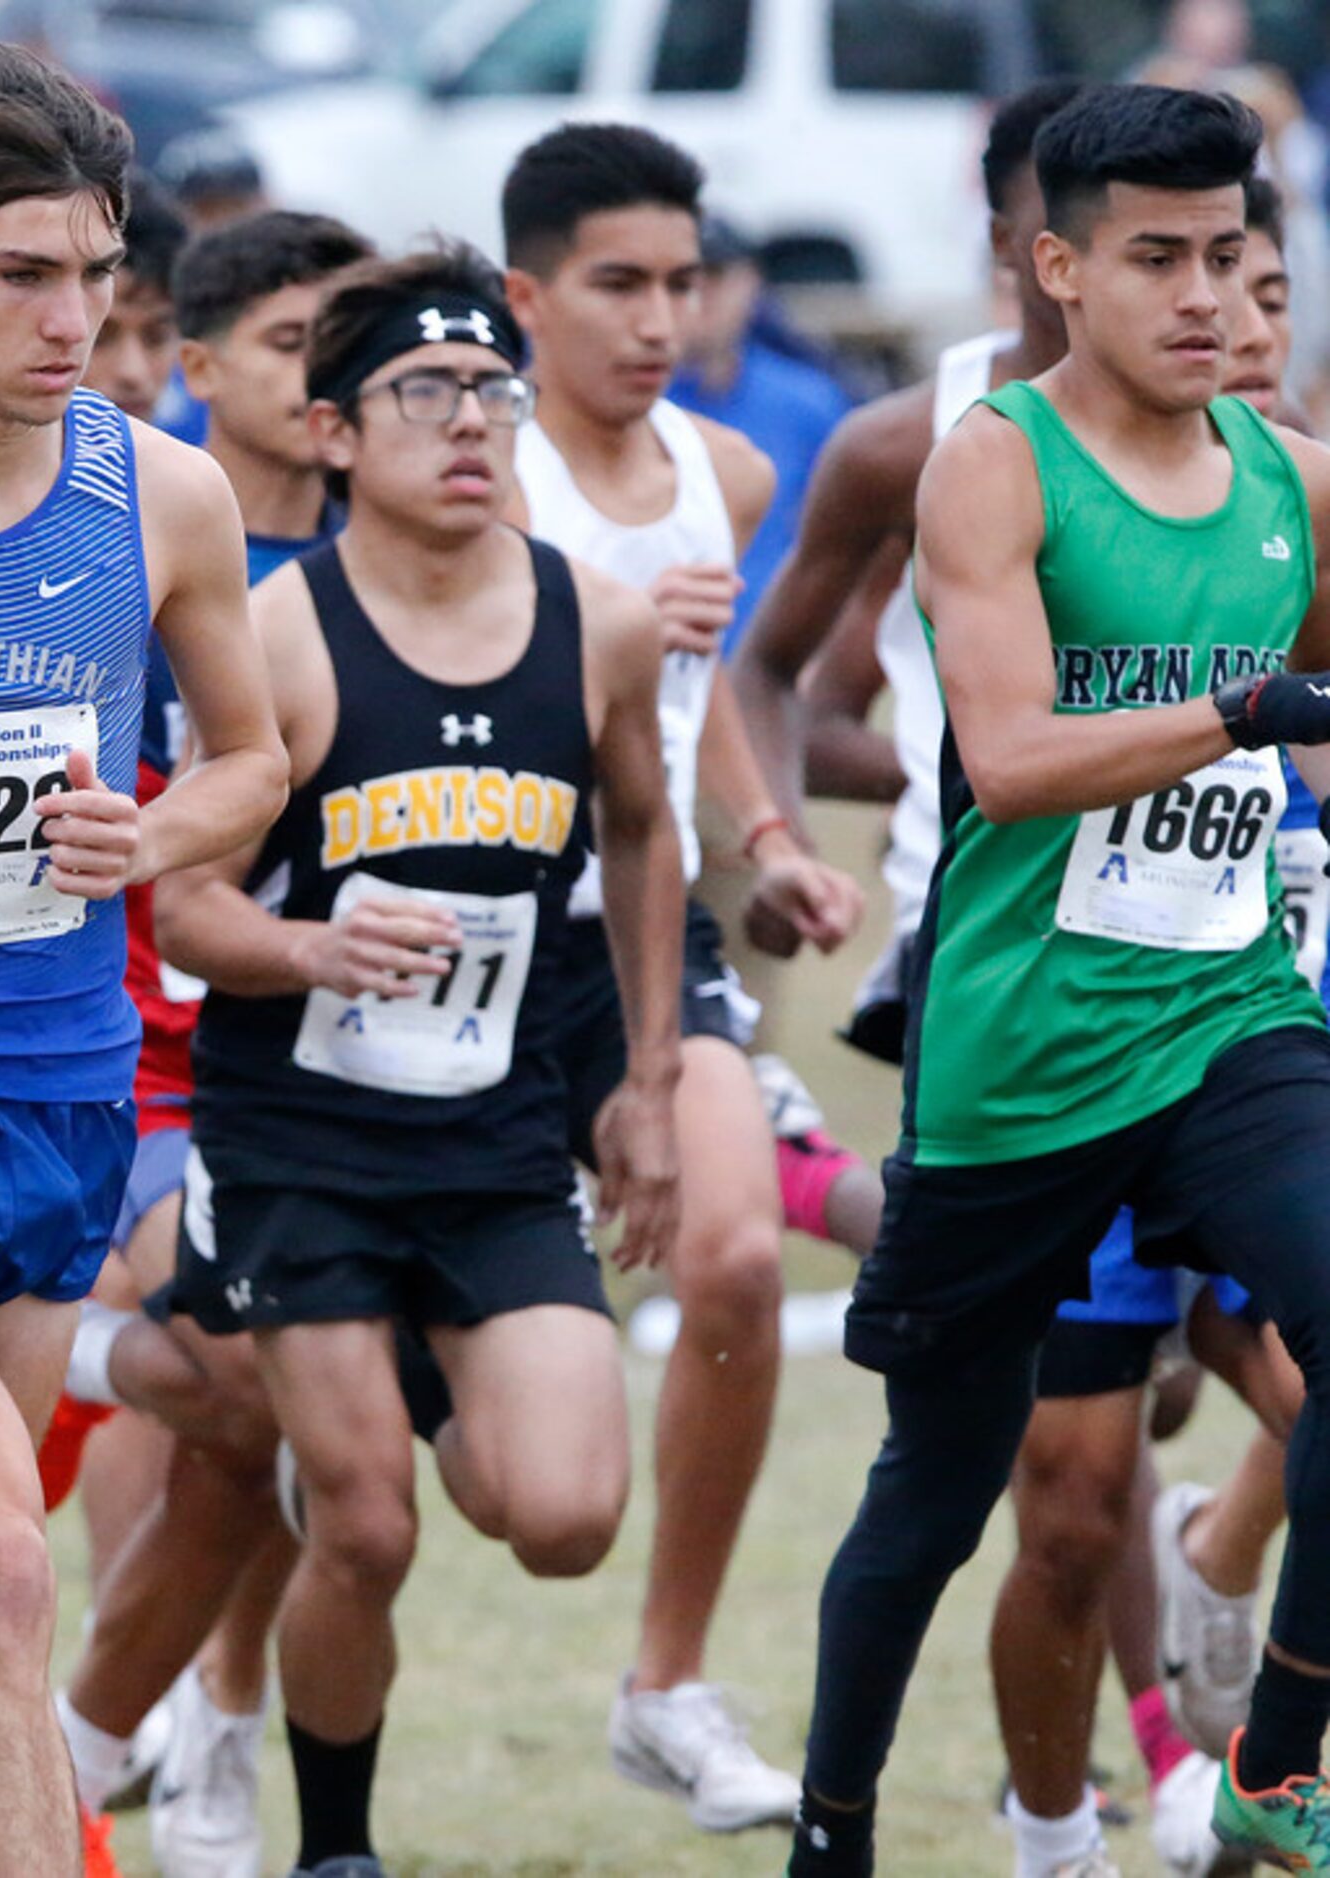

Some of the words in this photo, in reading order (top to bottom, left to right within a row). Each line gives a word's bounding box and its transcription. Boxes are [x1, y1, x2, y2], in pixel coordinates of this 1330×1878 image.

[1052, 643, 1191, 707] RYAN
[29, 724, 43, 740] II
[320, 765, 579, 870] DENISON
[1106, 778, 1273, 861] 1666
